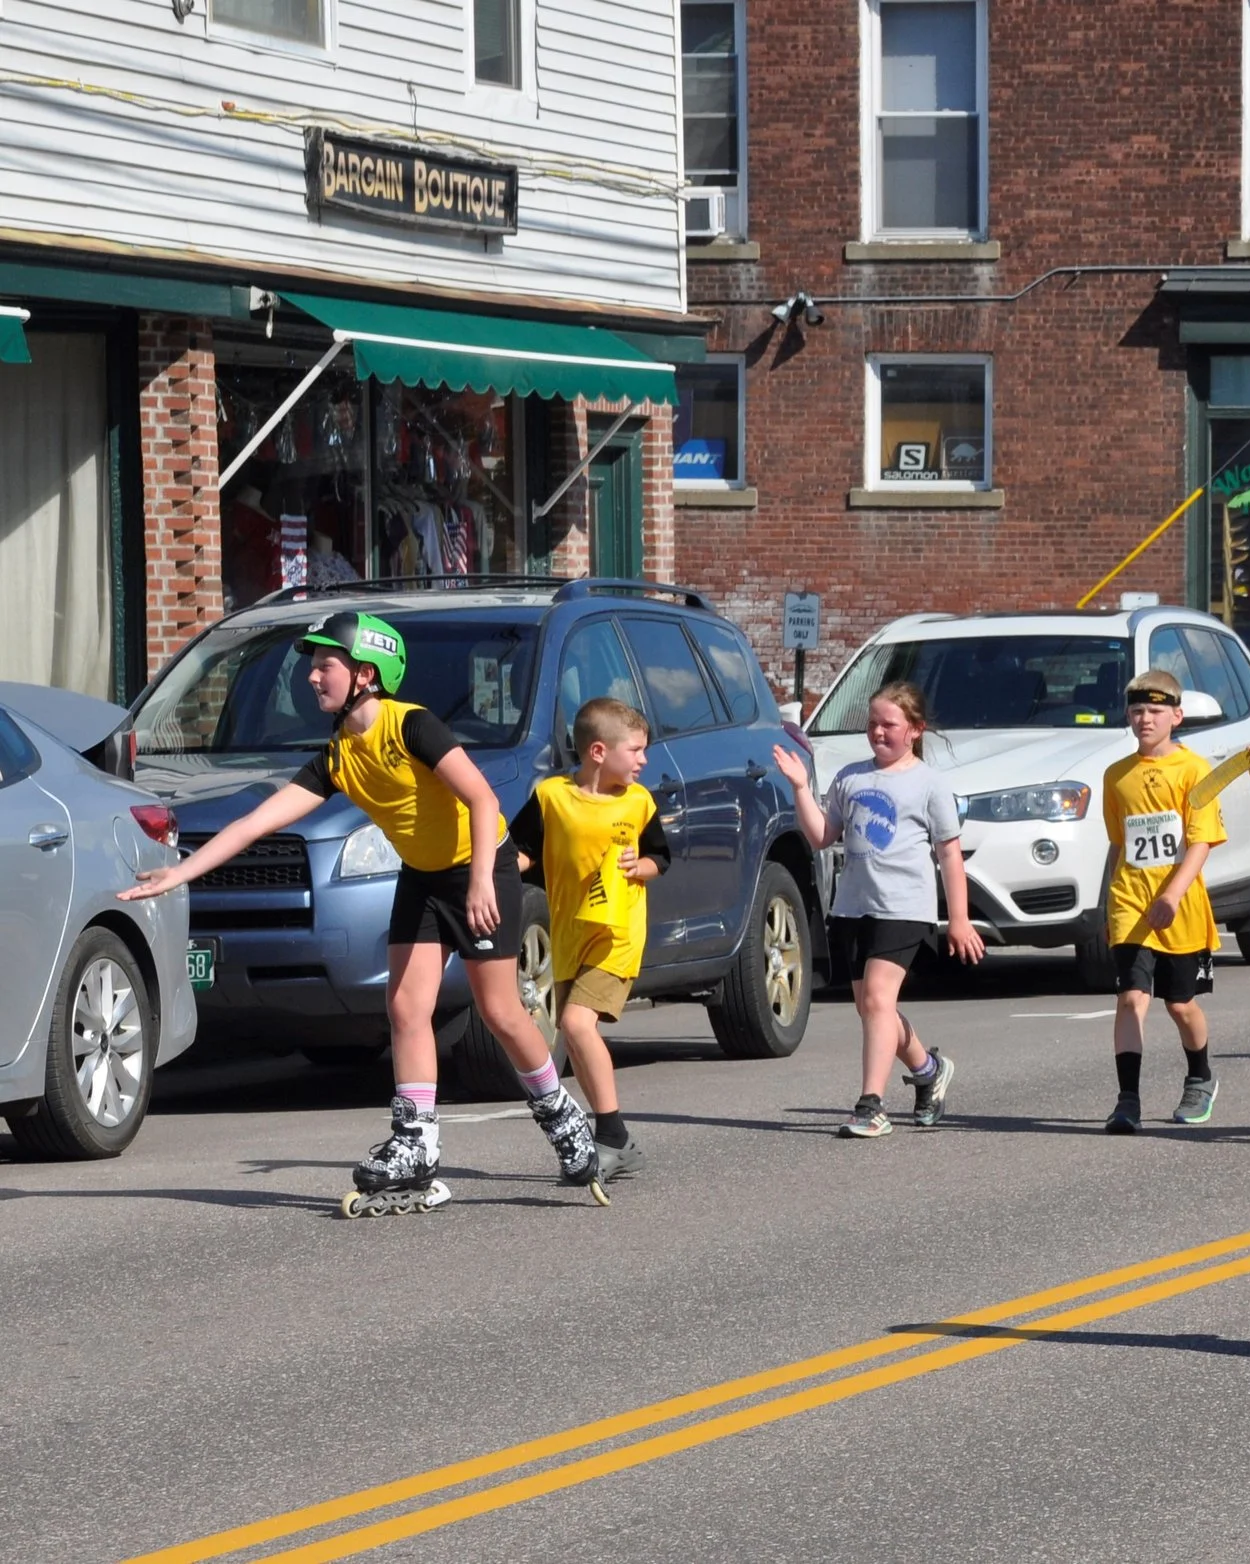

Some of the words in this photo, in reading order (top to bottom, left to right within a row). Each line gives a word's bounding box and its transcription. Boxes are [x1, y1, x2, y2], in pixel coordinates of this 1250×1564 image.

[324, 142, 403, 202] BARGAIN
[414, 158, 506, 221] BOUTIQUE
[673, 453, 721, 465] IANT
[884, 470, 938, 480] salomon
[789, 617, 815, 627] PARKING
[361, 628, 398, 654] YETI
[1128, 819, 1146, 828] GREEN
[1147, 814, 1177, 825] MOUNTAIN
[1134, 833, 1178, 861] 219
